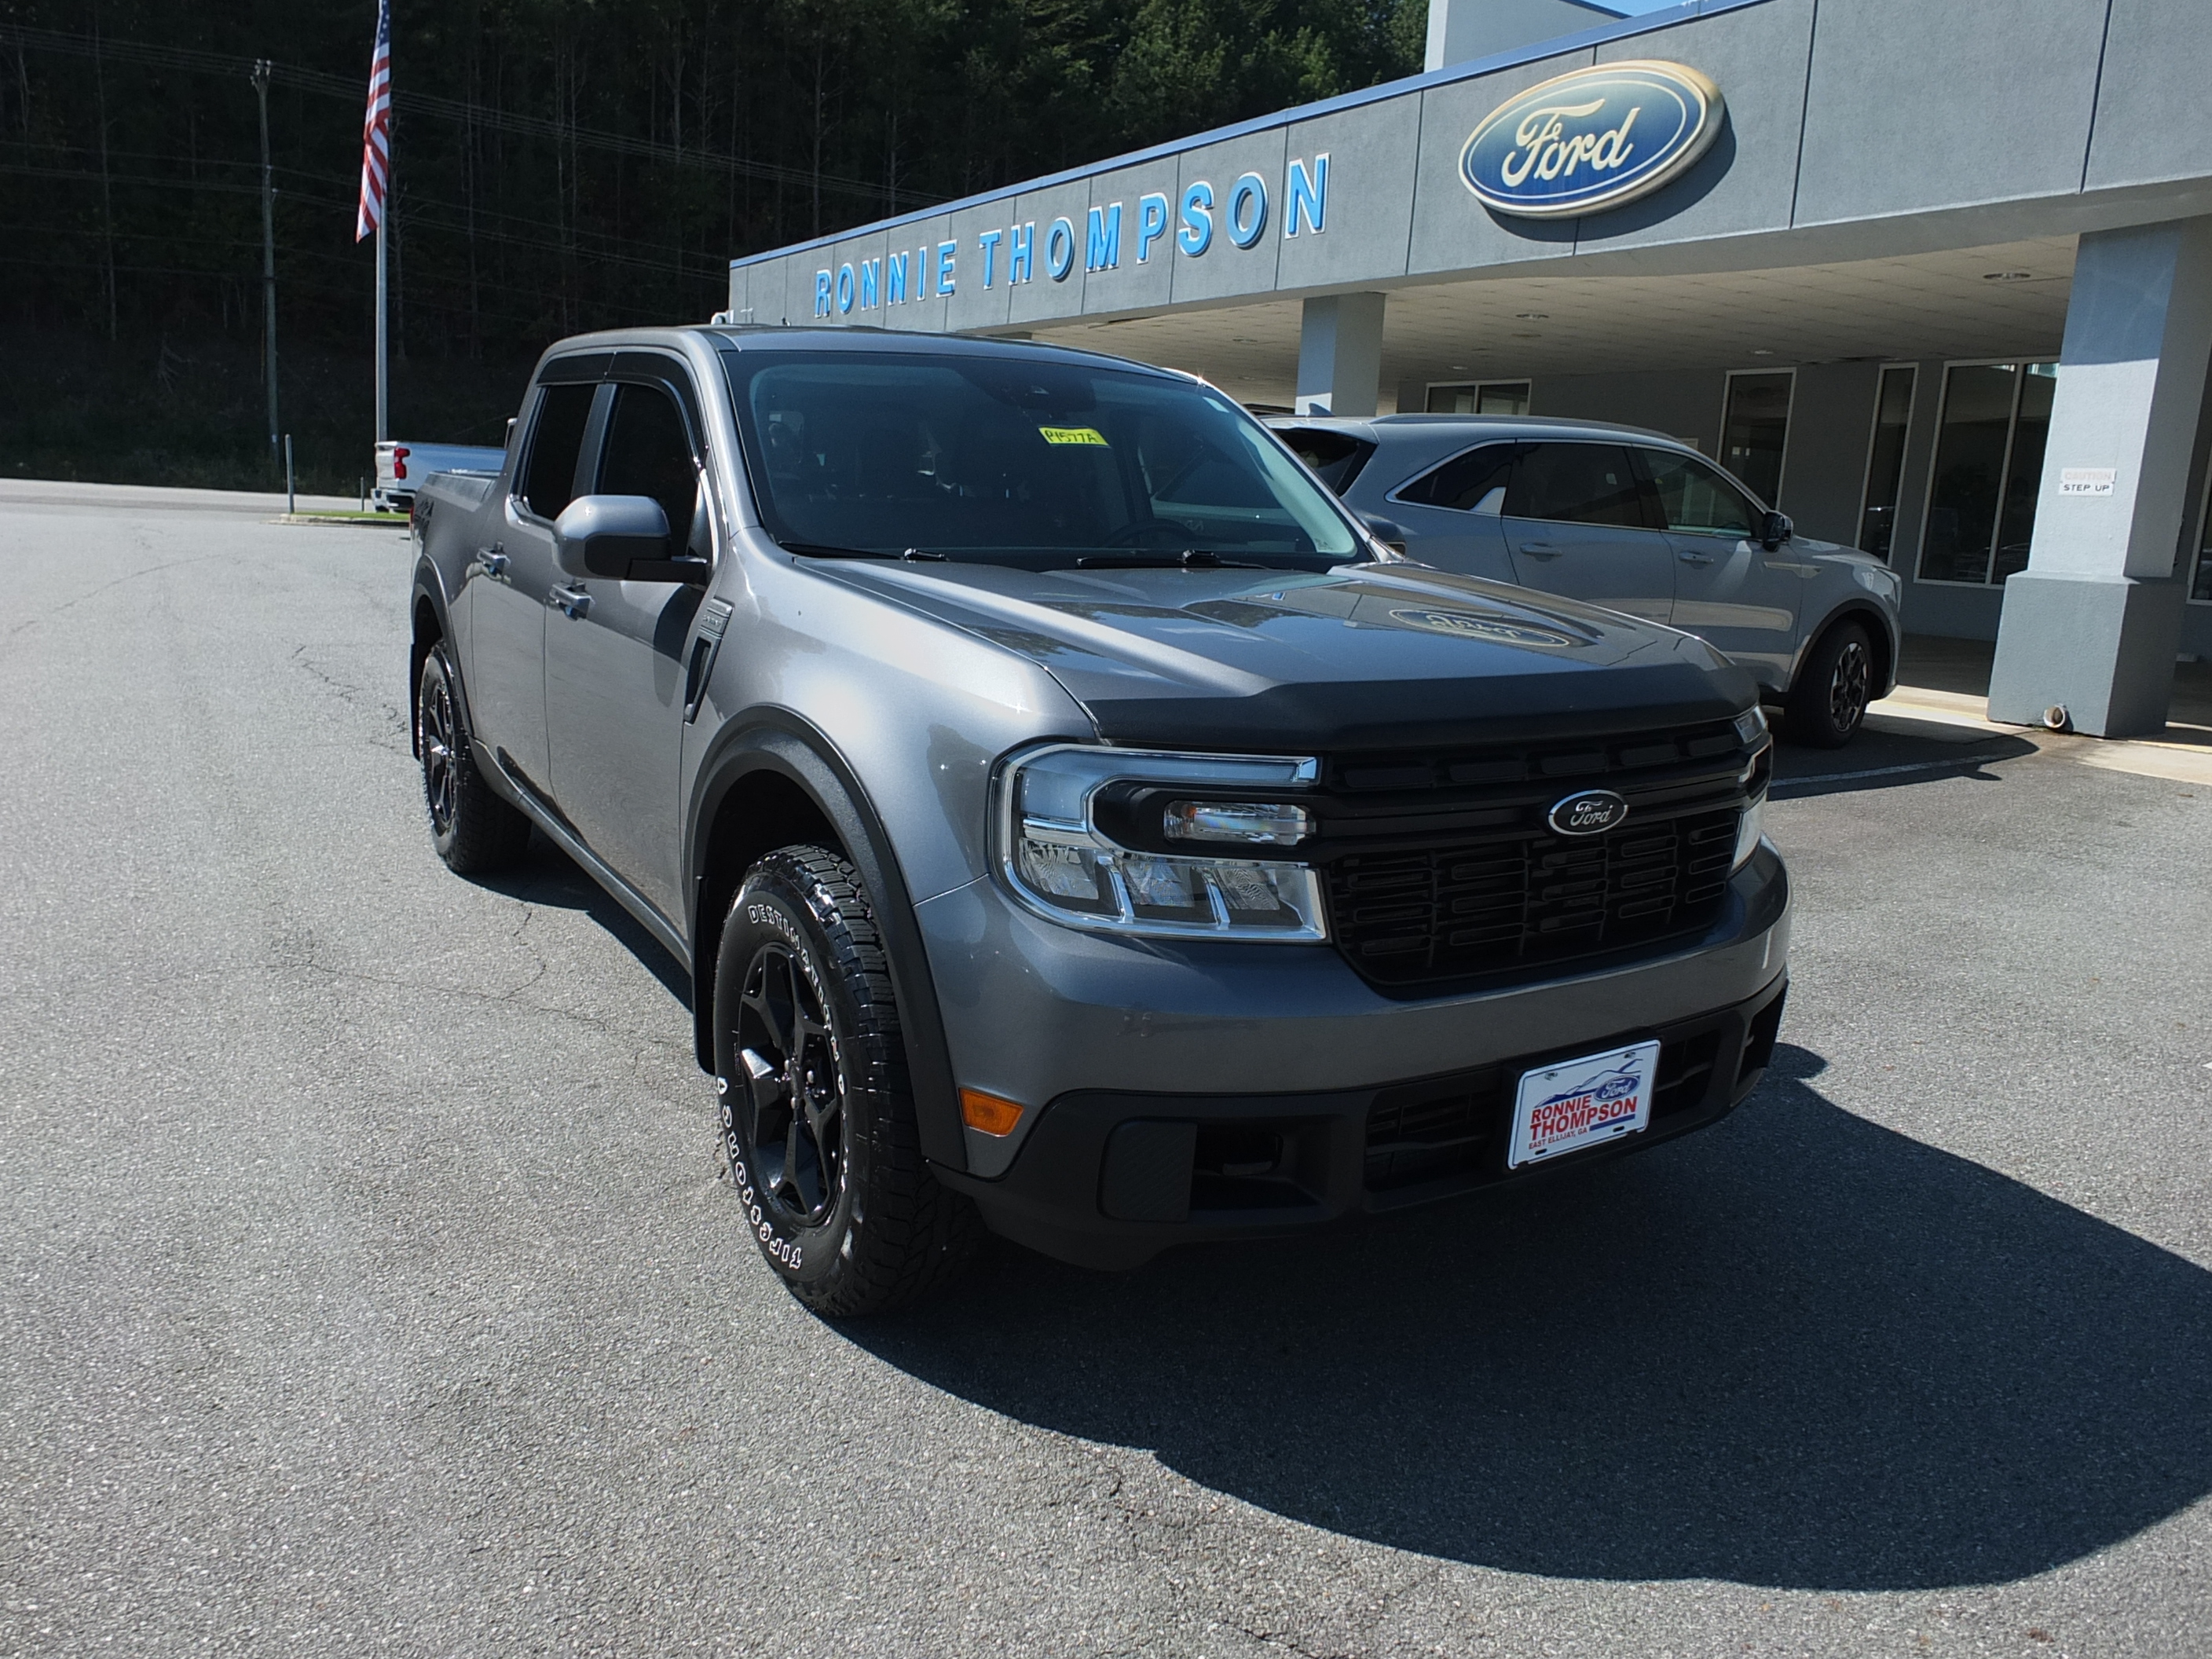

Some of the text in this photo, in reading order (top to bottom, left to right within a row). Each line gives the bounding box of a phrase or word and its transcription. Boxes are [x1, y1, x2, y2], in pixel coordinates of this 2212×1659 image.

[1501, 98, 1641, 187] Ford
[815, 152, 1330, 318] RONNIE THOMPSON
[1569, 800, 1613, 826] Ford
[1601, 1079, 1631, 1099] Ford
[1529, 1096, 1638, 1141] THOMPSON
[1531, 1094, 1592, 1124] RONNIE
[1529, 1126, 1588, 1149] EAST ELLIJAY, GA
